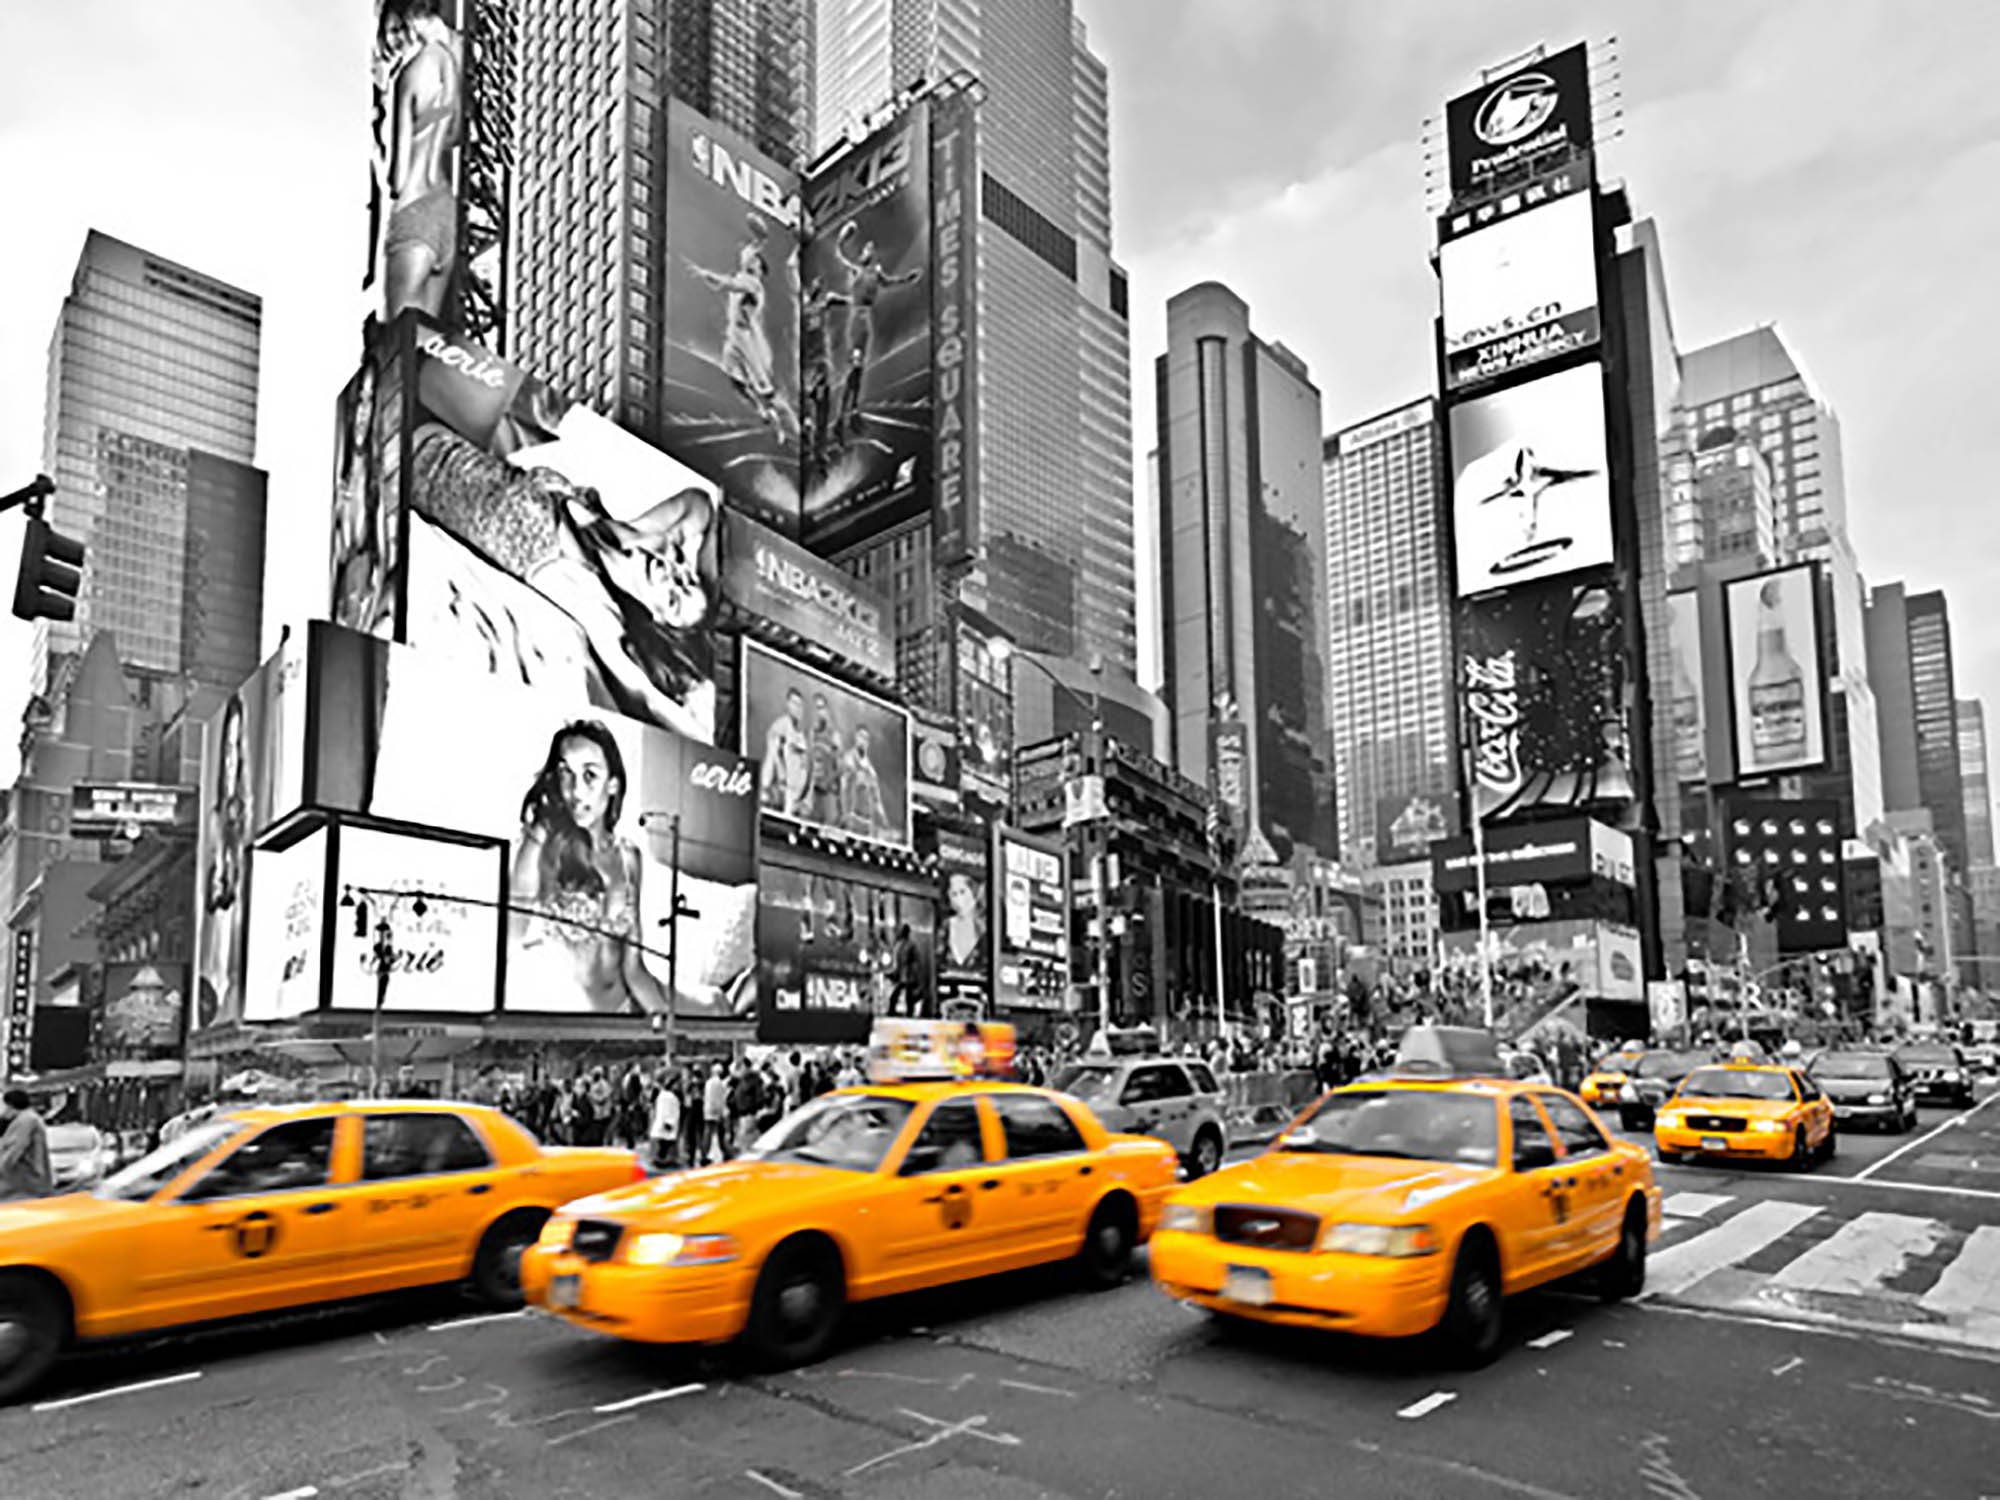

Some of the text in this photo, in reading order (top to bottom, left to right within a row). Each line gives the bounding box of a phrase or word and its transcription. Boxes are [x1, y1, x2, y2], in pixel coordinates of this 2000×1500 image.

[712, 143, 815, 236] NBA
[935, 129, 962, 287] TIMES
[935, 305, 963, 512] SQUARE
[1477, 322, 1565, 363] XINHUA
[1465, 650, 1521, 793] Coca-Cola
